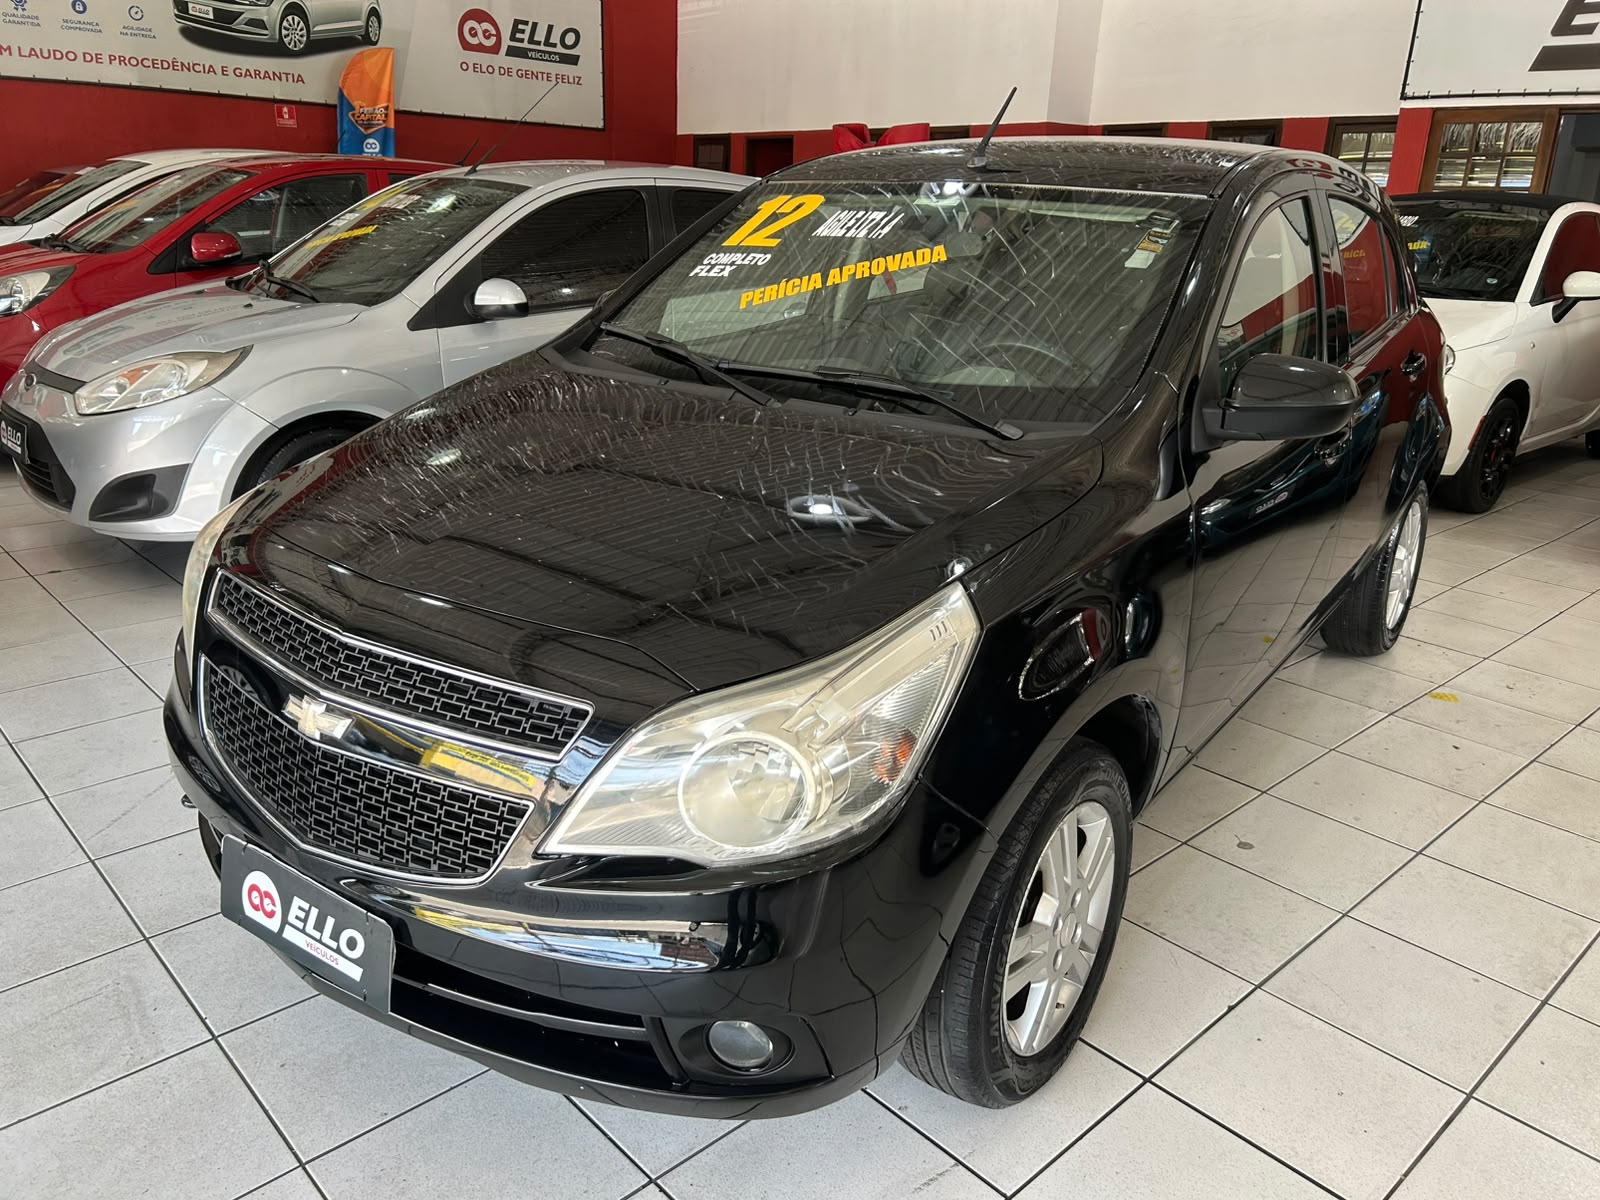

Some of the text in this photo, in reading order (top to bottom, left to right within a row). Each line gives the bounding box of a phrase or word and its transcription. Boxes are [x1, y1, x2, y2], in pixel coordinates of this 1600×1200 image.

[1, 12, 40, 21] QUALIDADE
[2, 19, 42, 28] GARANTIDA
[61, 18, 100, 28] SEGURANÇA
[122, 25, 153, 33] AGILIDADE
[60, 25, 103, 34] COMPROVADA
[509, 18, 581, 51] ELLO
[130, 32, 157, 40] ENTREGA
[527, 51, 560, 62] VEÍCULOS
[17, 46, 78, 62] LAUDO
[82, 52, 104, 65] DE
[108, 54, 217, 76] PROCEDÊNCIA
[220, 65, 230, 77] E
[232, 66, 306, 85] GARANTIA
[460, 61, 583, 86] O ELO DE GENTE FELIZ
[721, 194, 826, 248] 12
[703, 253, 772, 266] COMPLETO
[688, 265, 738, 277] FLEX
[739, 245, 949, 310] PERÍCIA APROVADA
[8, 425, 22, 446] ELLO
[288, 895, 365, 960] ELLO
